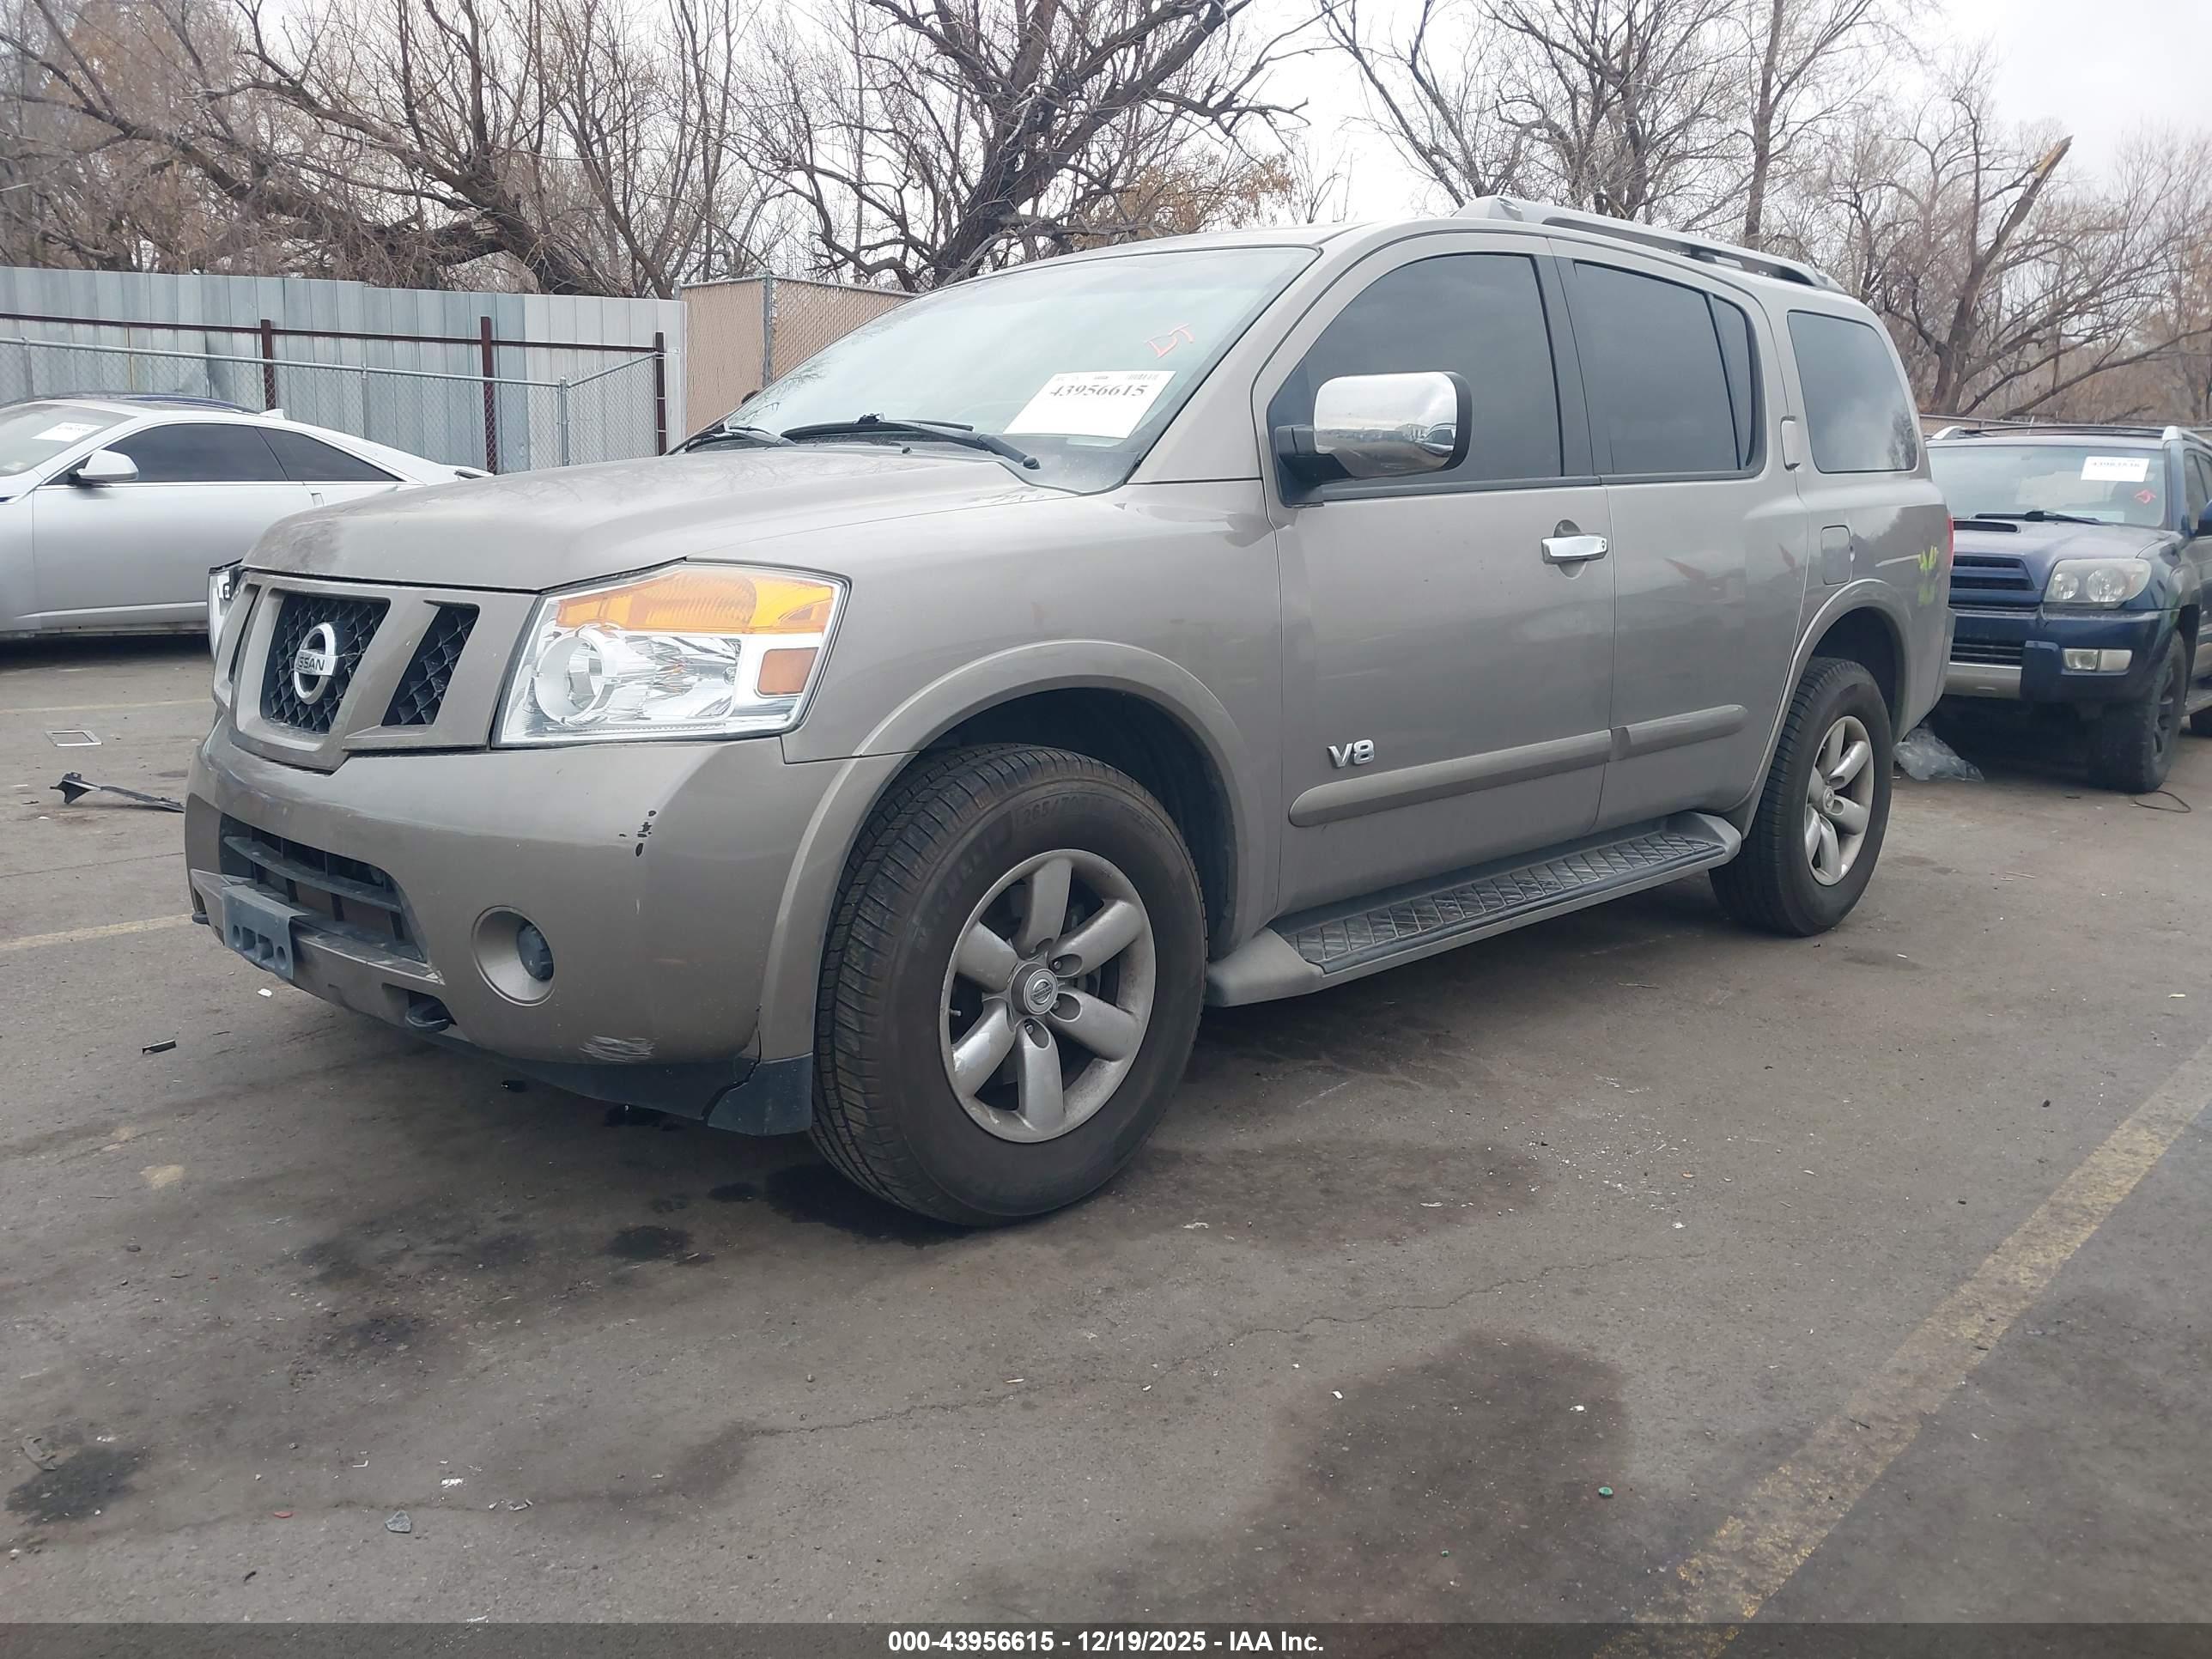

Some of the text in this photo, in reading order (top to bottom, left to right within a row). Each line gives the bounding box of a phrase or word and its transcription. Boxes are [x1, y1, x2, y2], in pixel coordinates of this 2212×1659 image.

[1049, 384, 1149, 397] 43956615
[296, 656, 325, 672] SSAN
[1326, 739, 1375, 768] V8
